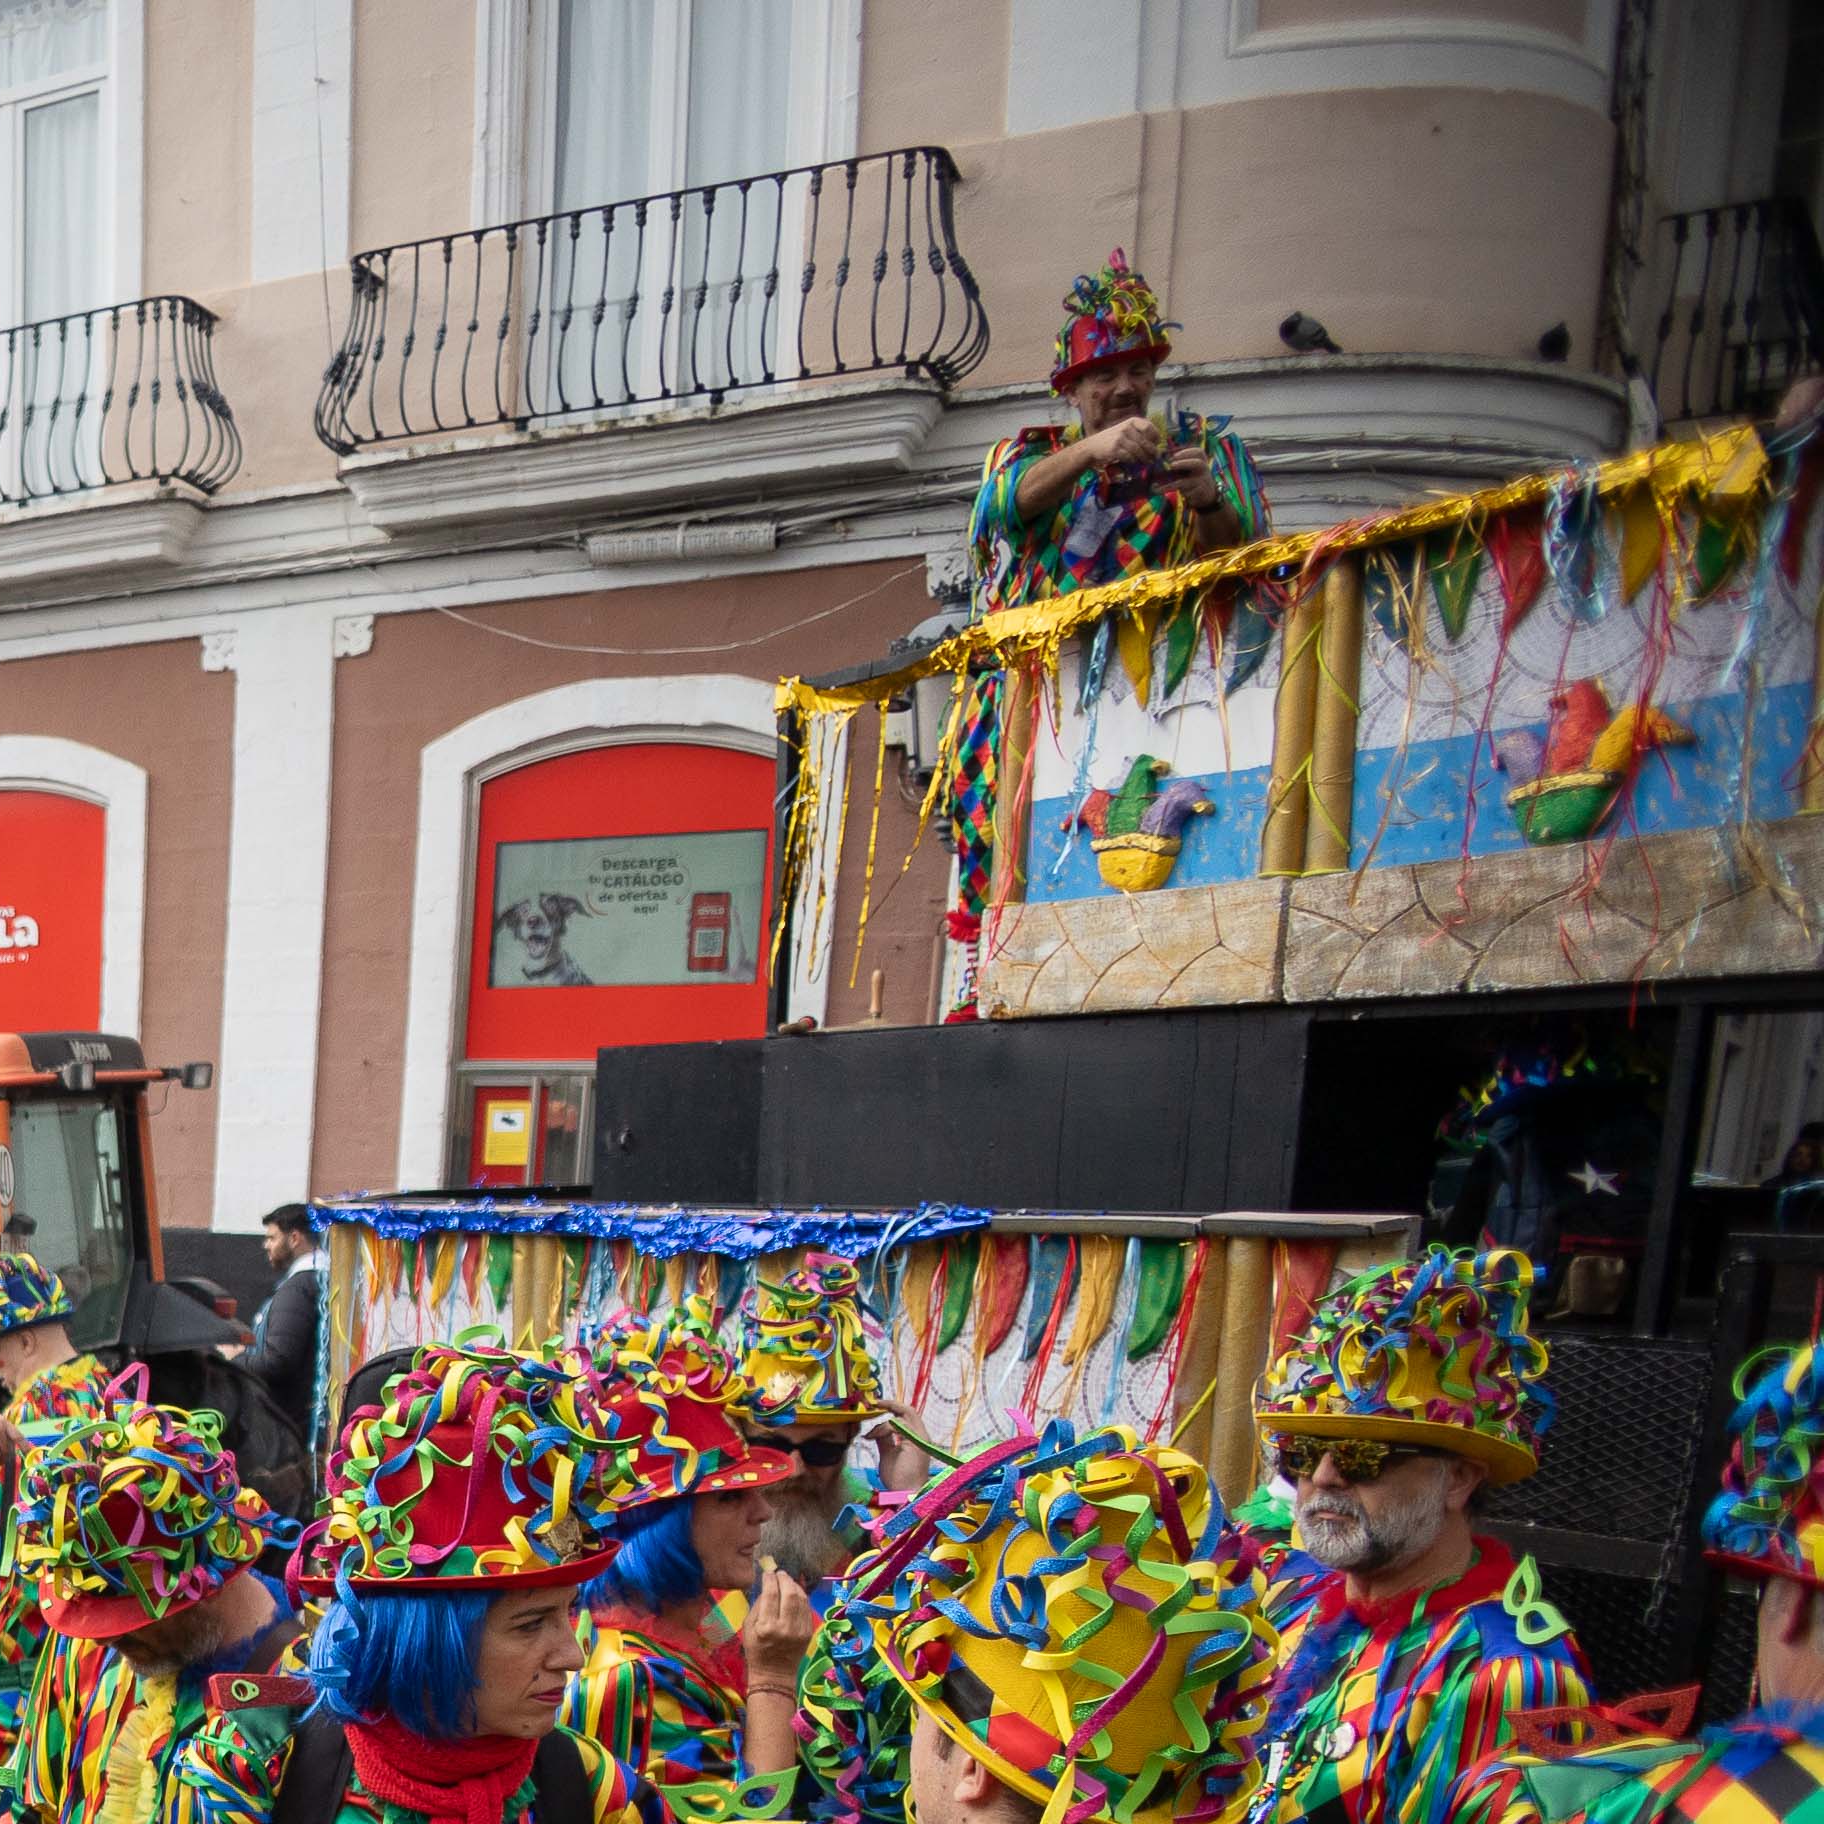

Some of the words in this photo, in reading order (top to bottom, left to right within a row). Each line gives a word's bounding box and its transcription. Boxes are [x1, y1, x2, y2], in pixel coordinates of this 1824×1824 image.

[601, 855, 678, 871] Descarga
[603, 870, 684, 889] CATÁLOGO
[598, 892, 615, 903] de
[618, 889, 668, 903] ofertas
